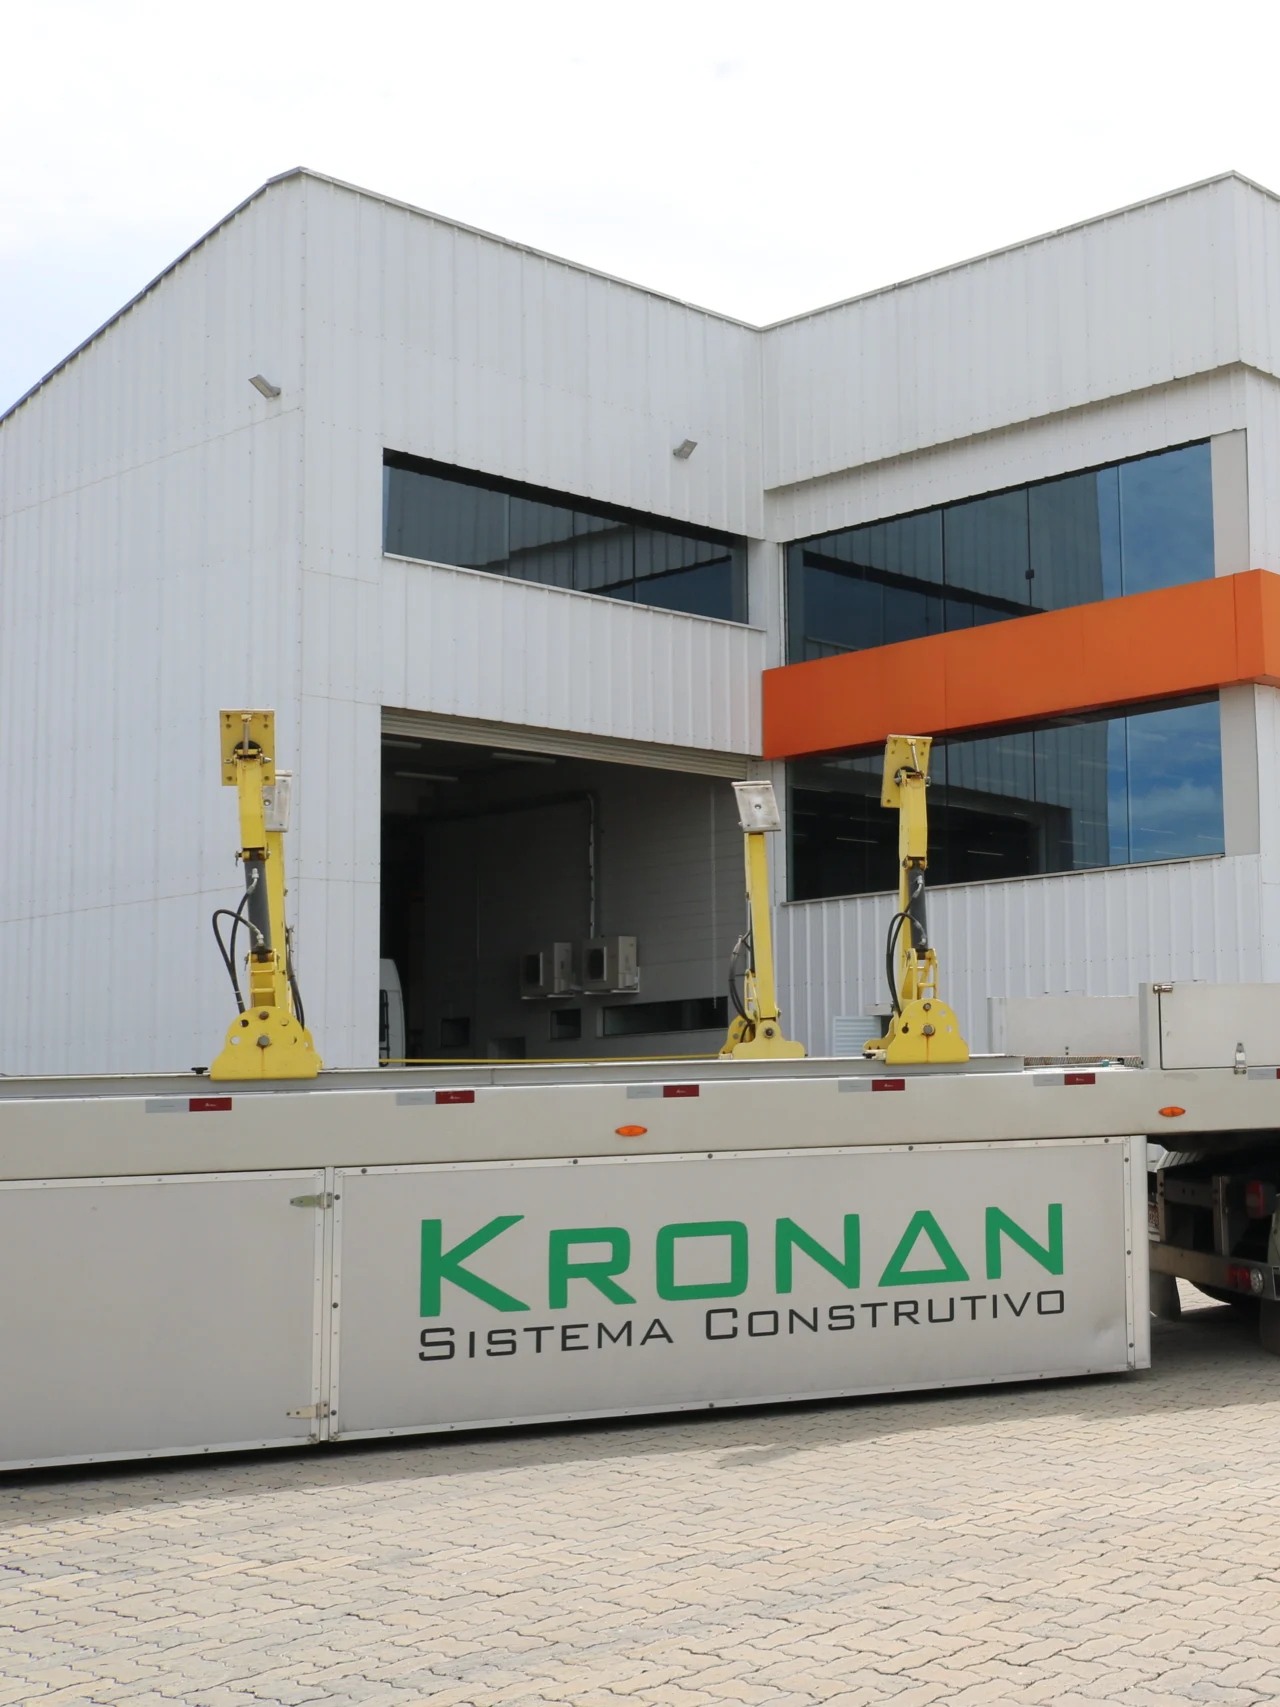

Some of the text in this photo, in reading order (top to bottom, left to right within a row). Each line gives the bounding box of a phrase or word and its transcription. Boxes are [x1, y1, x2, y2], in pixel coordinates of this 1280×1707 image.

[420, 1203, 1065, 1318] KRONAN
[418, 1289, 1066, 1362] SISTEMA CONSTRUTIVO
